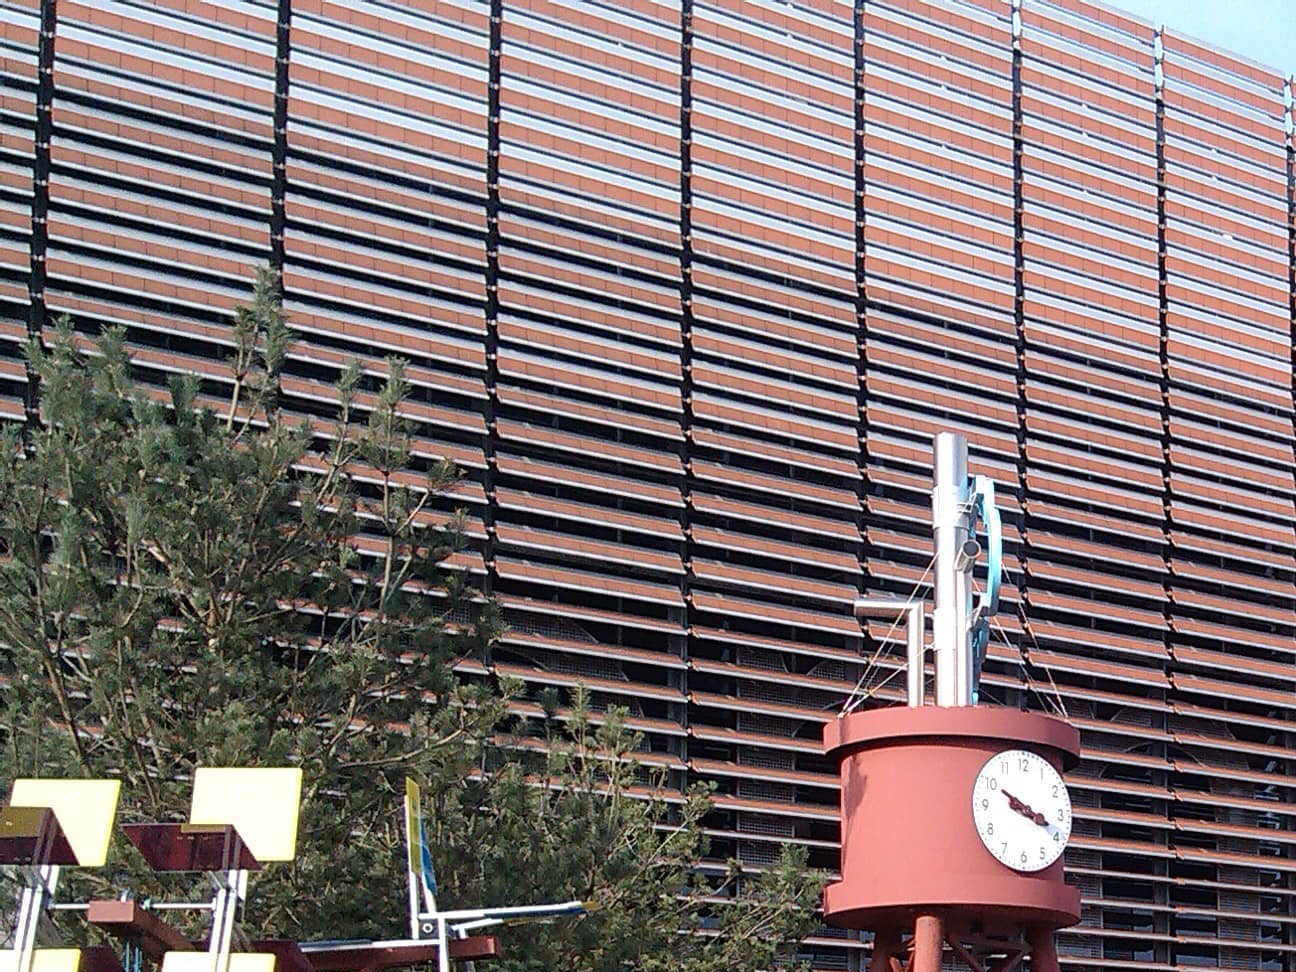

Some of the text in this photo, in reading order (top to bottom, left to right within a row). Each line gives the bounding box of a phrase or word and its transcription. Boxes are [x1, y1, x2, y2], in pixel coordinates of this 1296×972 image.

[1001, 761, 1009, 775] 11
[1017, 758, 1030, 772] 12
[985, 777, 998, 791] 10
[1051, 785, 1059, 799] 2
[981, 798, 989, 812] 9
[1057, 808, 1064, 822] 3
[986, 822, 994, 836] 8
[1052, 831, 1060, 843] 4
[1001, 842, 1008, 855] 7
[1039, 847, 1046, 861] 5
[1020, 850, 1028, 864] 6
